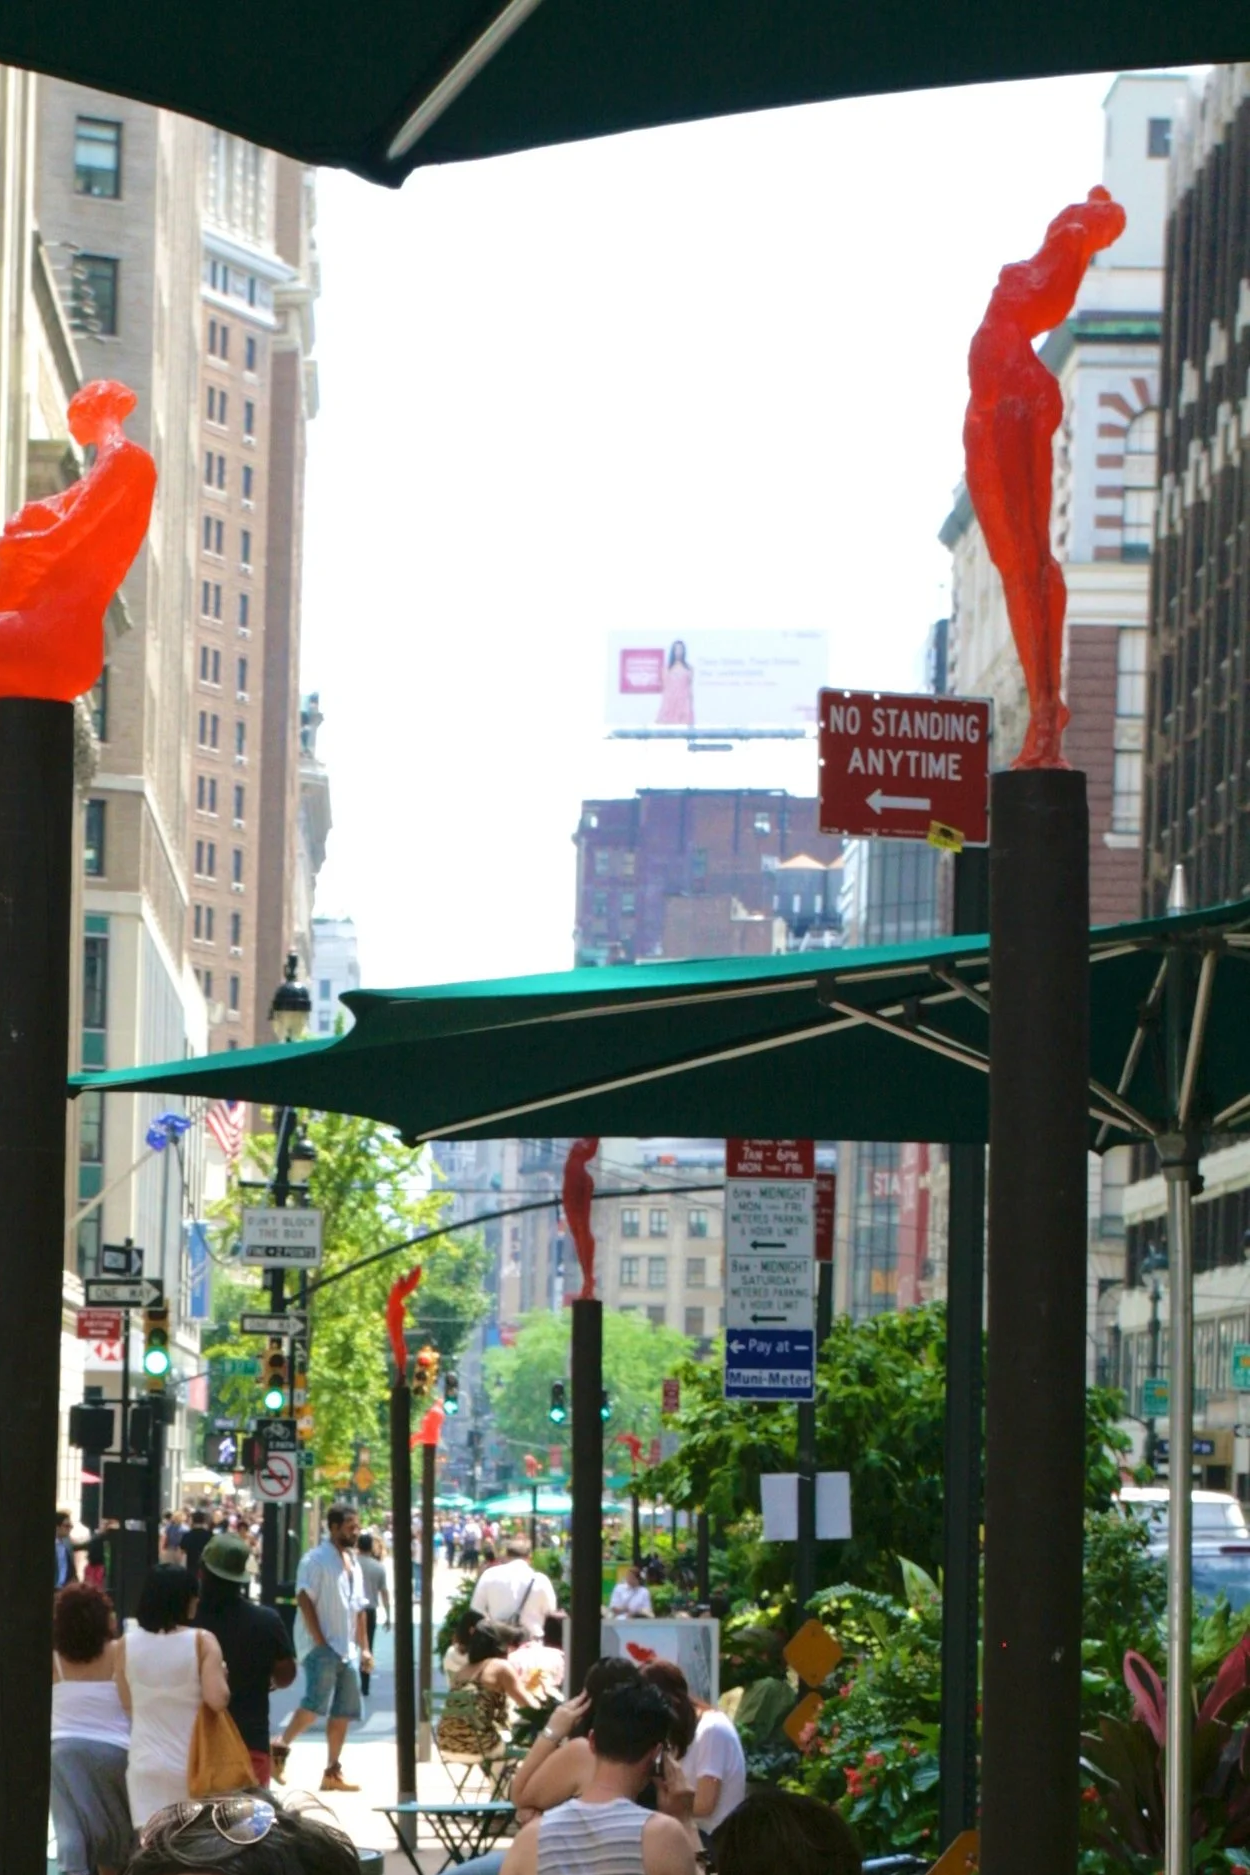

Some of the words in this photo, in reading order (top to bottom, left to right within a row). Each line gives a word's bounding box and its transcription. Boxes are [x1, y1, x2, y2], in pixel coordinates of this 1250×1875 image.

[829, 704, 861, 736] NO
[871, 707, 980, 744] STANDING
[847, 747, 963, 782] ANYTIME
[737, 1162, 762, 1173] MON
[785, 1162, 804, 1174] FRI
[760, 1187, 806, 1200] MIDNIGHT
[282, 1216, 316, 1227] BLOCK
[258, 1228, 278, 1239] THE
[283, 1229, 305, 1239] BOX
[761, 1260, 808, 1274] MIDNIGHT
[741, 1275, 798, 1287] SATURDAY
[96, 1286, 118, 1300] ONE
[129, 1286, 153, 1300] WAY
[747, 1337, 772, 1357] Pay
[775, 1340, 790, 1354] at
[729, 1370, 810, 1387] Muni-Meter
